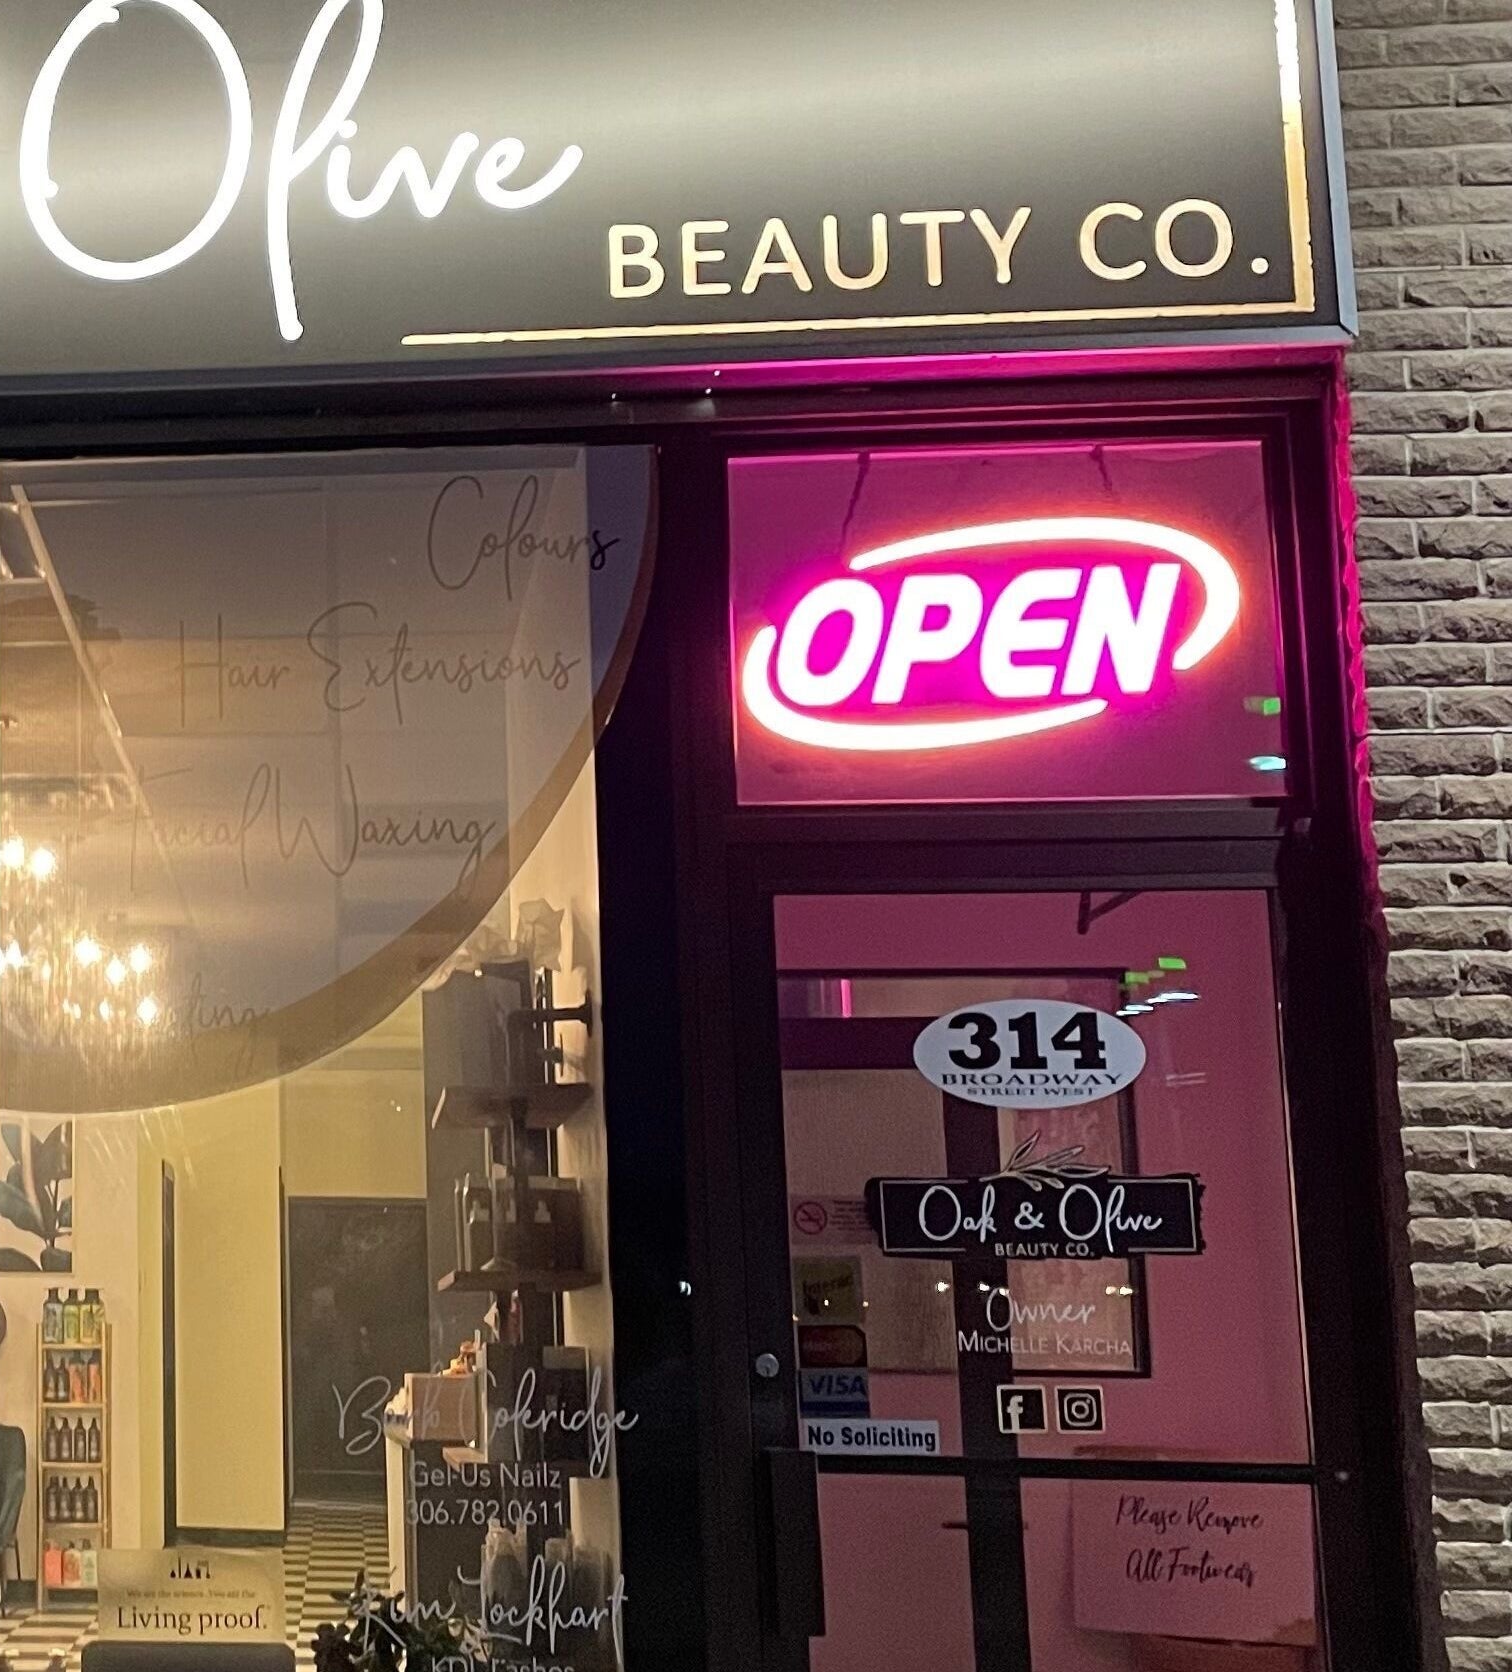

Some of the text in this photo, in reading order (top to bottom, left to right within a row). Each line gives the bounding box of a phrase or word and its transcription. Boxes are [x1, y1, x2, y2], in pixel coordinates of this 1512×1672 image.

[19, 0, 583, 340] Olive
[607, 198, 1269, 299] BEAUTY CO.
[426, 475, 620, 600] Colours
[778, 563, 1181, 707] OPEN
[178, 602, 581, 728] Hair Extensions
[275, 763, 497, 903] Waxing
[948, 1011, 1108, 1071] 314
[942, 1073, 1121, 1086] BROADWAY
[966, 1087, 1094, 1096] STREET WEST
[919, 1183, 997, 1243] Oak
[1014, 1201, 1046, 1230] &
[1059, 1183, 1163, 1253] Olive
[995, 1243, 1095, 1257] BEAUTY CO.
[986, 1287, 1097, 1332] Owner
[808, 1374, 867, 1396] VISA
[808, 1425, 936, 1452] No Soliciting
[500, 1461, 562, 1488] Nailz
[406, 1498, 564, 1526] 306.782.0611
[1116, 1493, 1264, 1535] Please Remove
[1126, 1545, 1257, 1588] All Footwear
[118, 1603, 268, 1636] Living proof.
